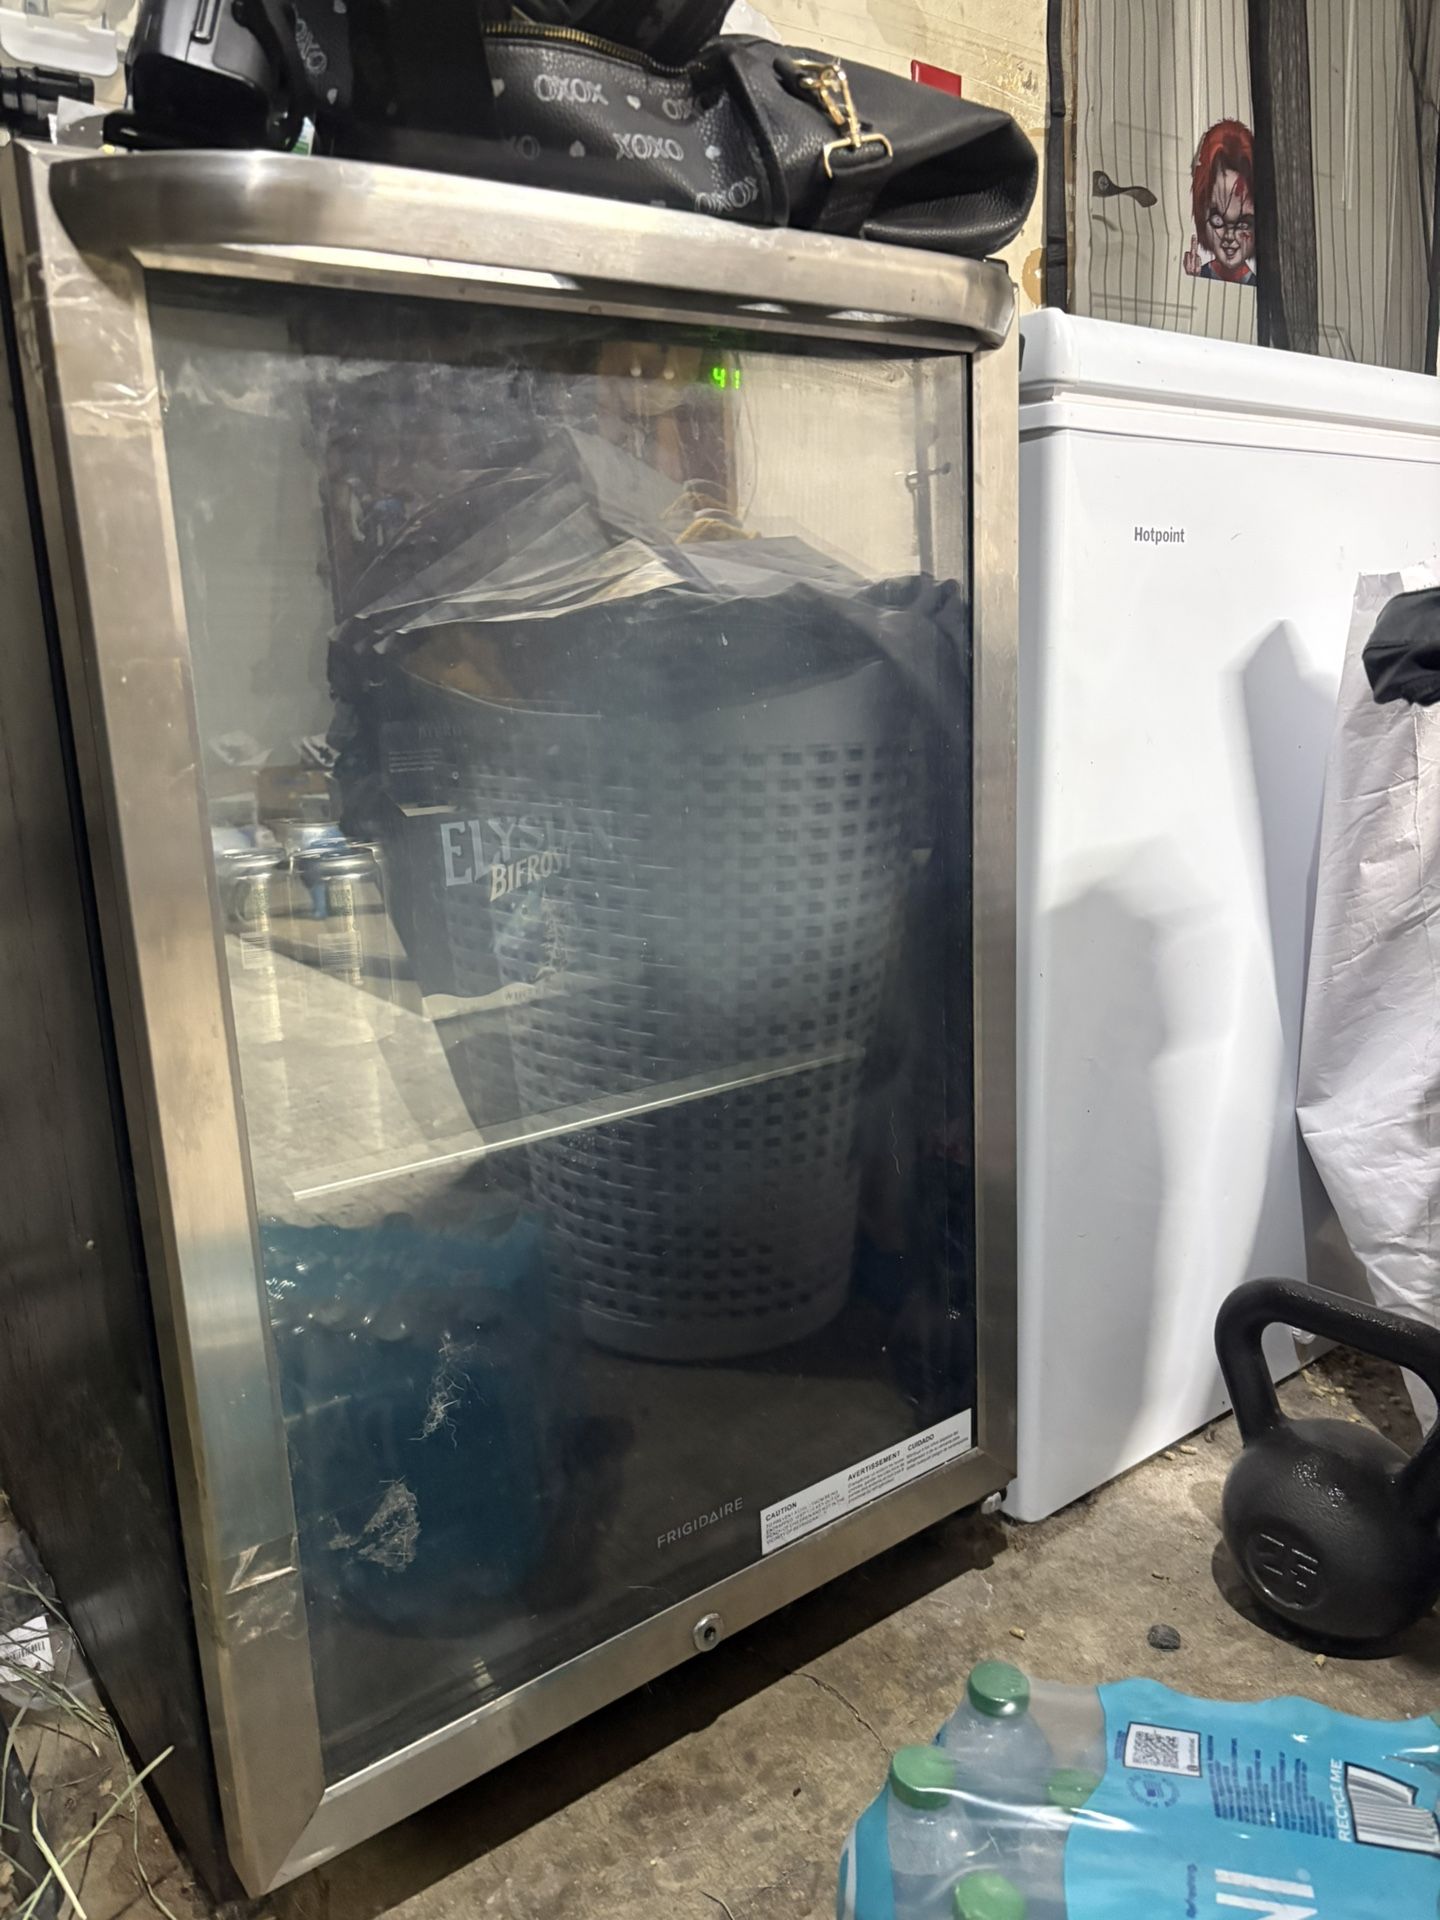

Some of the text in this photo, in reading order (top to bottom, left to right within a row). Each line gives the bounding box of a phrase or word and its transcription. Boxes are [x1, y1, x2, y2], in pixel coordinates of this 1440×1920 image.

[613, 133, 685, 161] XOXO
[712, 367, 740, 389] 41
[1134, 526, 1185, 546] Hotpoint
[907, 1433, 935, 1451] CUIDADO
[847, 1450, 902, 1481] AVERTISSEMENT
[765, 1501, 798, 1522] CAUTION
[657, 1497, 743, 1549] FRIGIDAIRE
